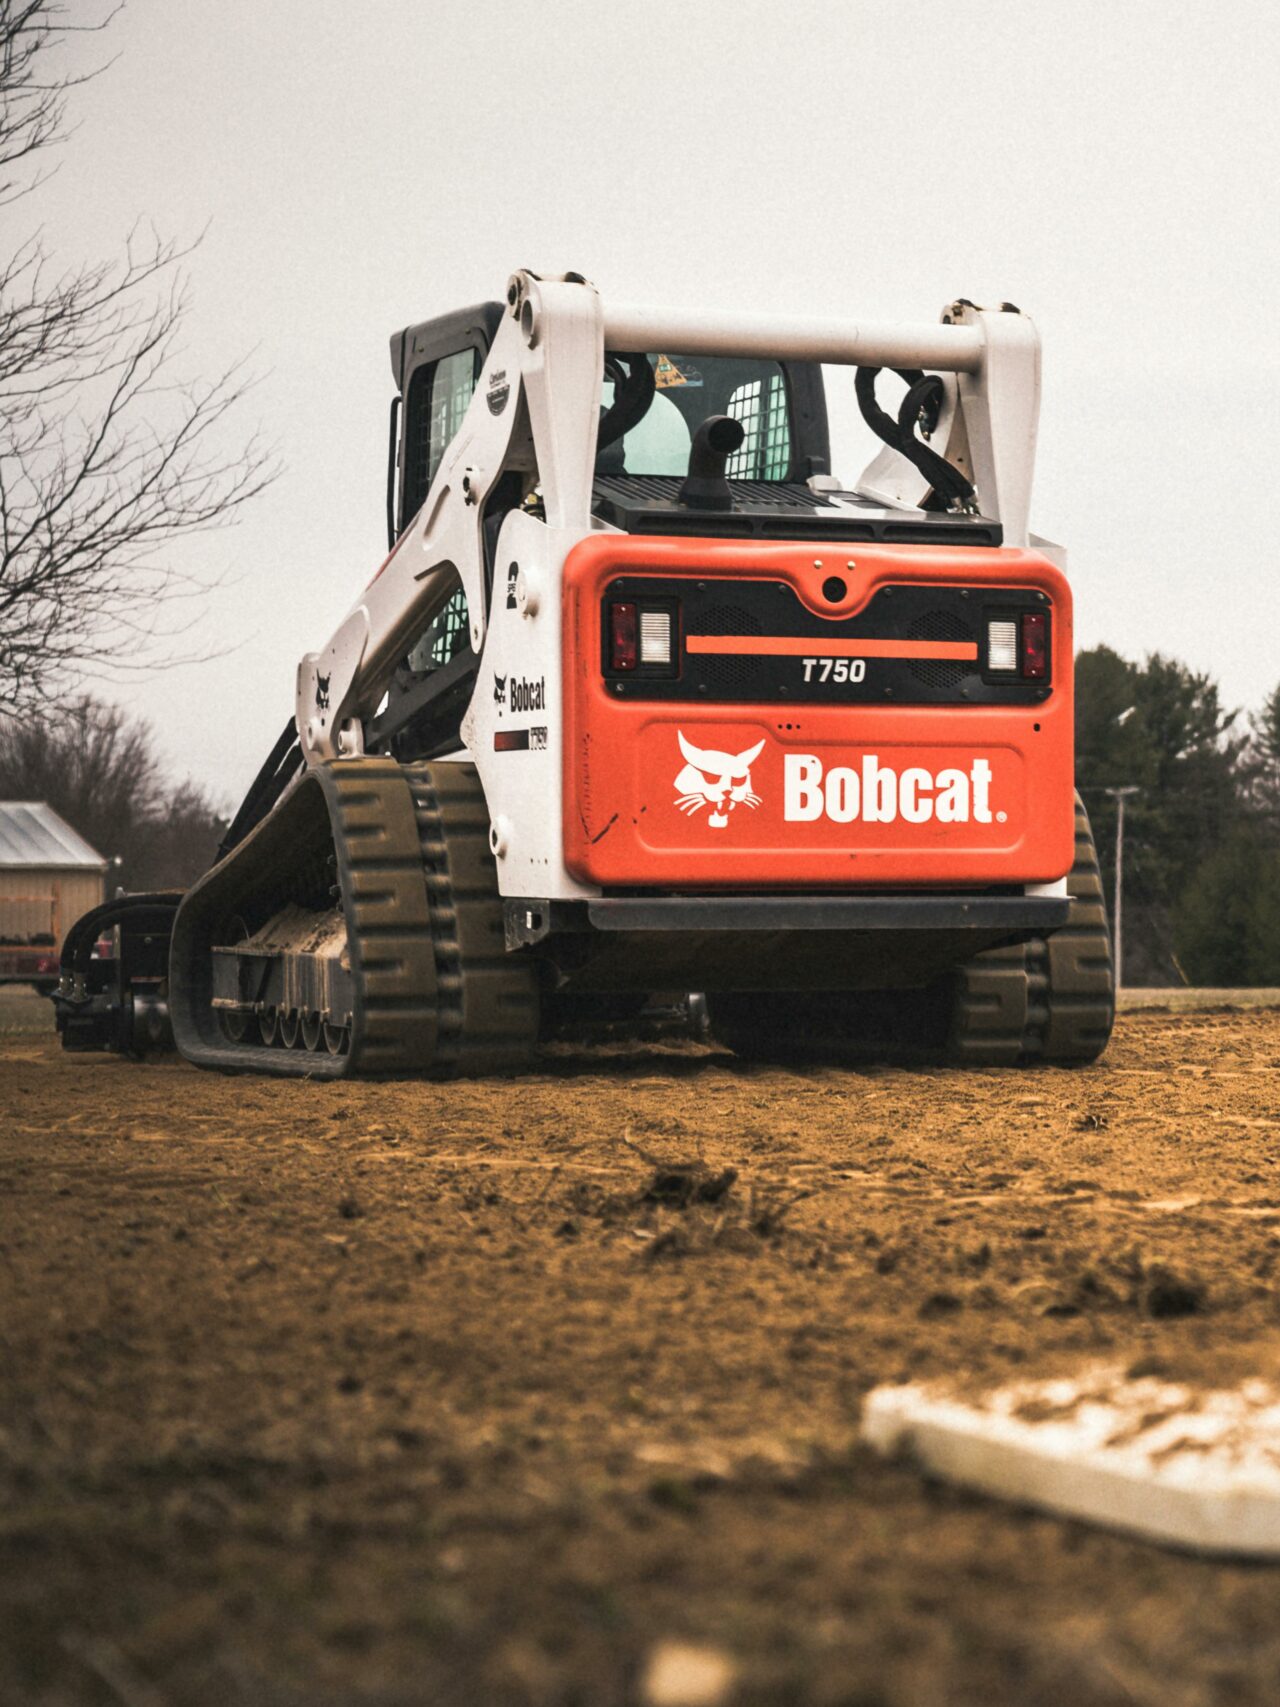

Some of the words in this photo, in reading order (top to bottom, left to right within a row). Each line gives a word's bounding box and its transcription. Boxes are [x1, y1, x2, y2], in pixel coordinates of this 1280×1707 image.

[802, 658, 866, 683] T750
[510, 675, 545, 713] Bobcat
[783, 753, 993, 824] Bobcat
